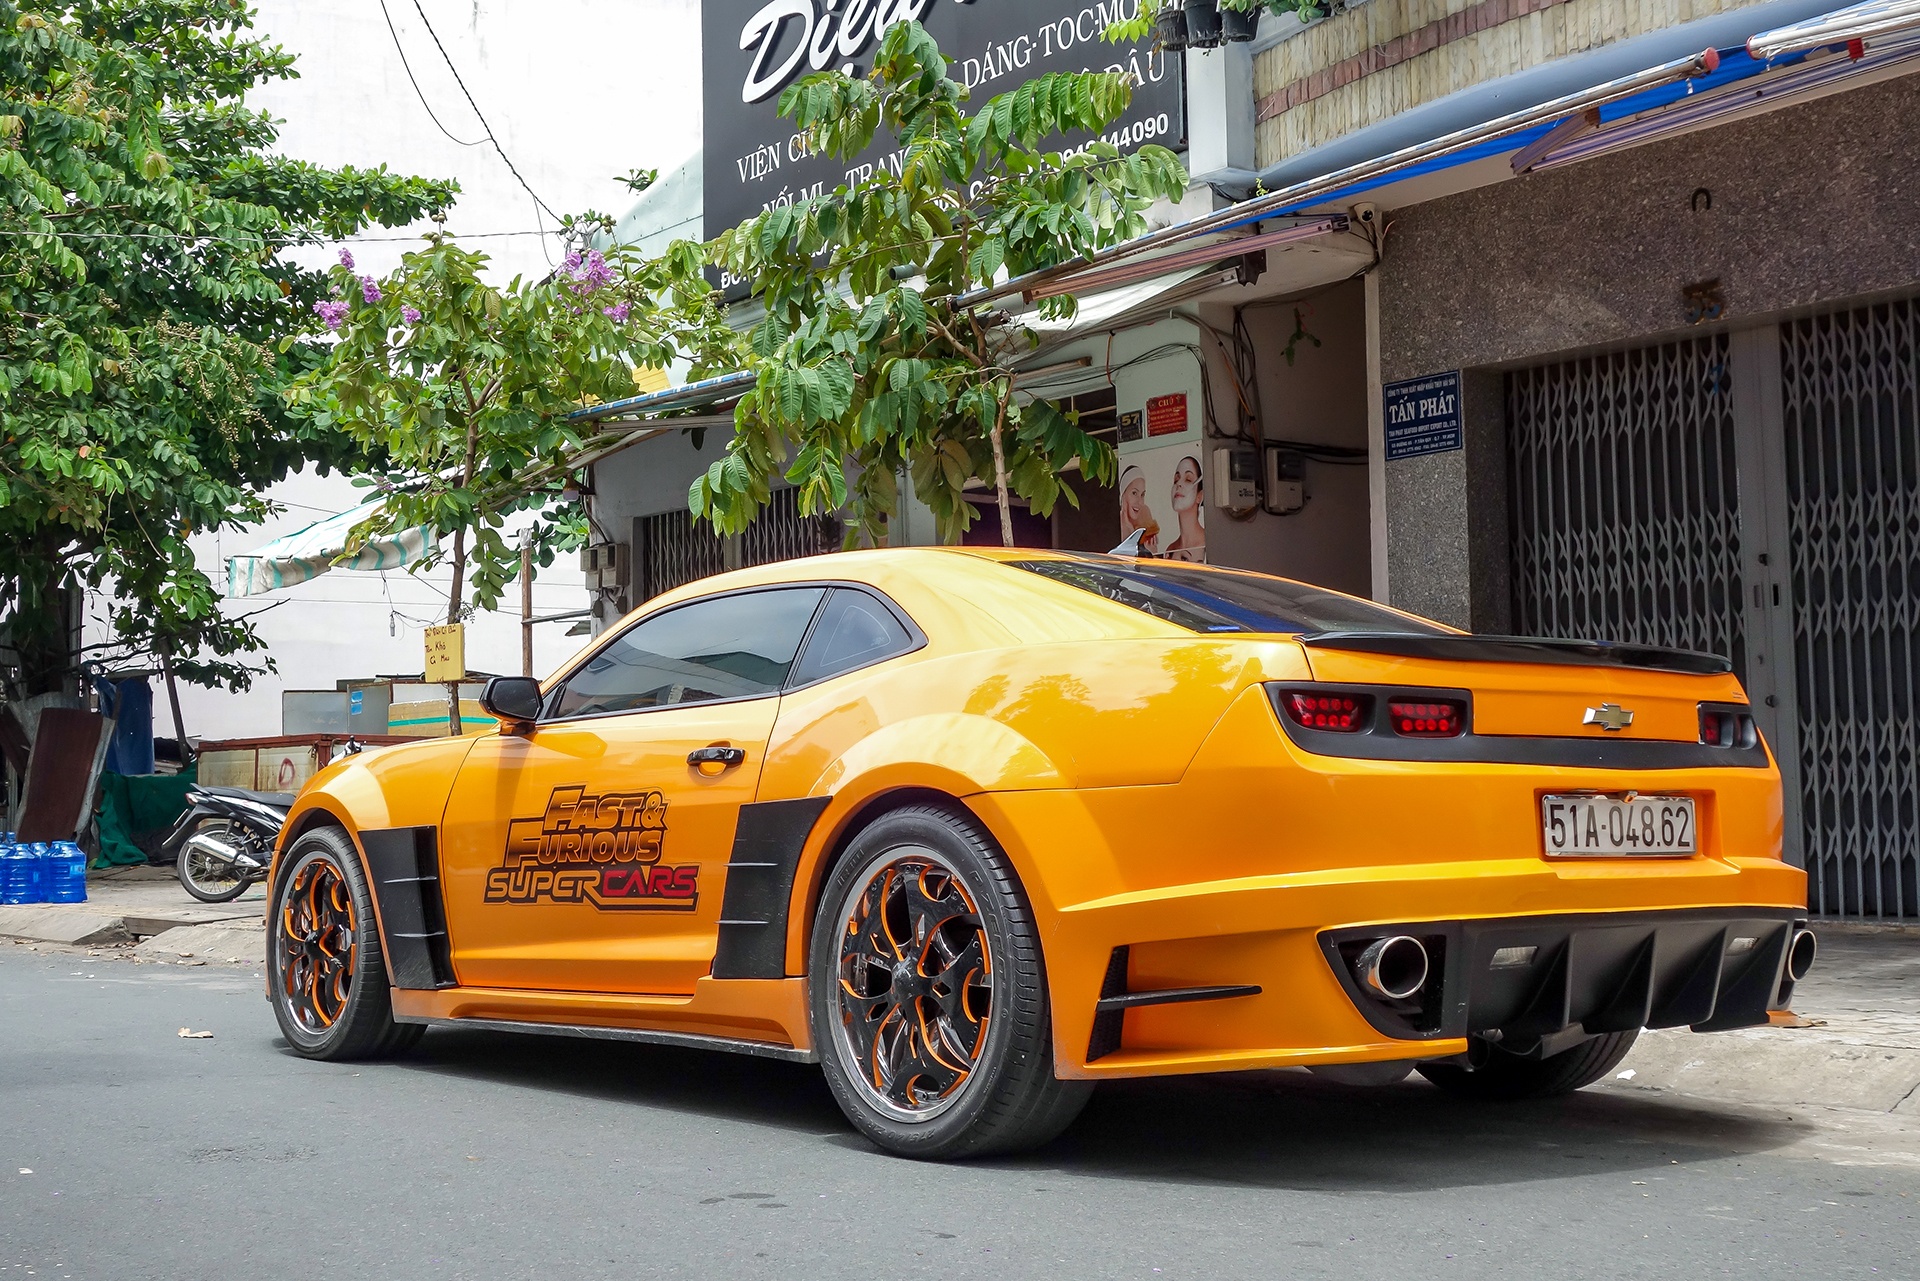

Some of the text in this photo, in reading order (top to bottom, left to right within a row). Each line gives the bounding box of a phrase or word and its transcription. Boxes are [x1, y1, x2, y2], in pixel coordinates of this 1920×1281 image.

[736, 141, 781, 183] VIỆN
[1121, 412, 1140, 427] 57
[1388, 390, 1455, 424] TẤN PHÁT
[506, 819, 662, 868] FURIOUS
[1550, 803, 1691, 848] 51A-048.62
